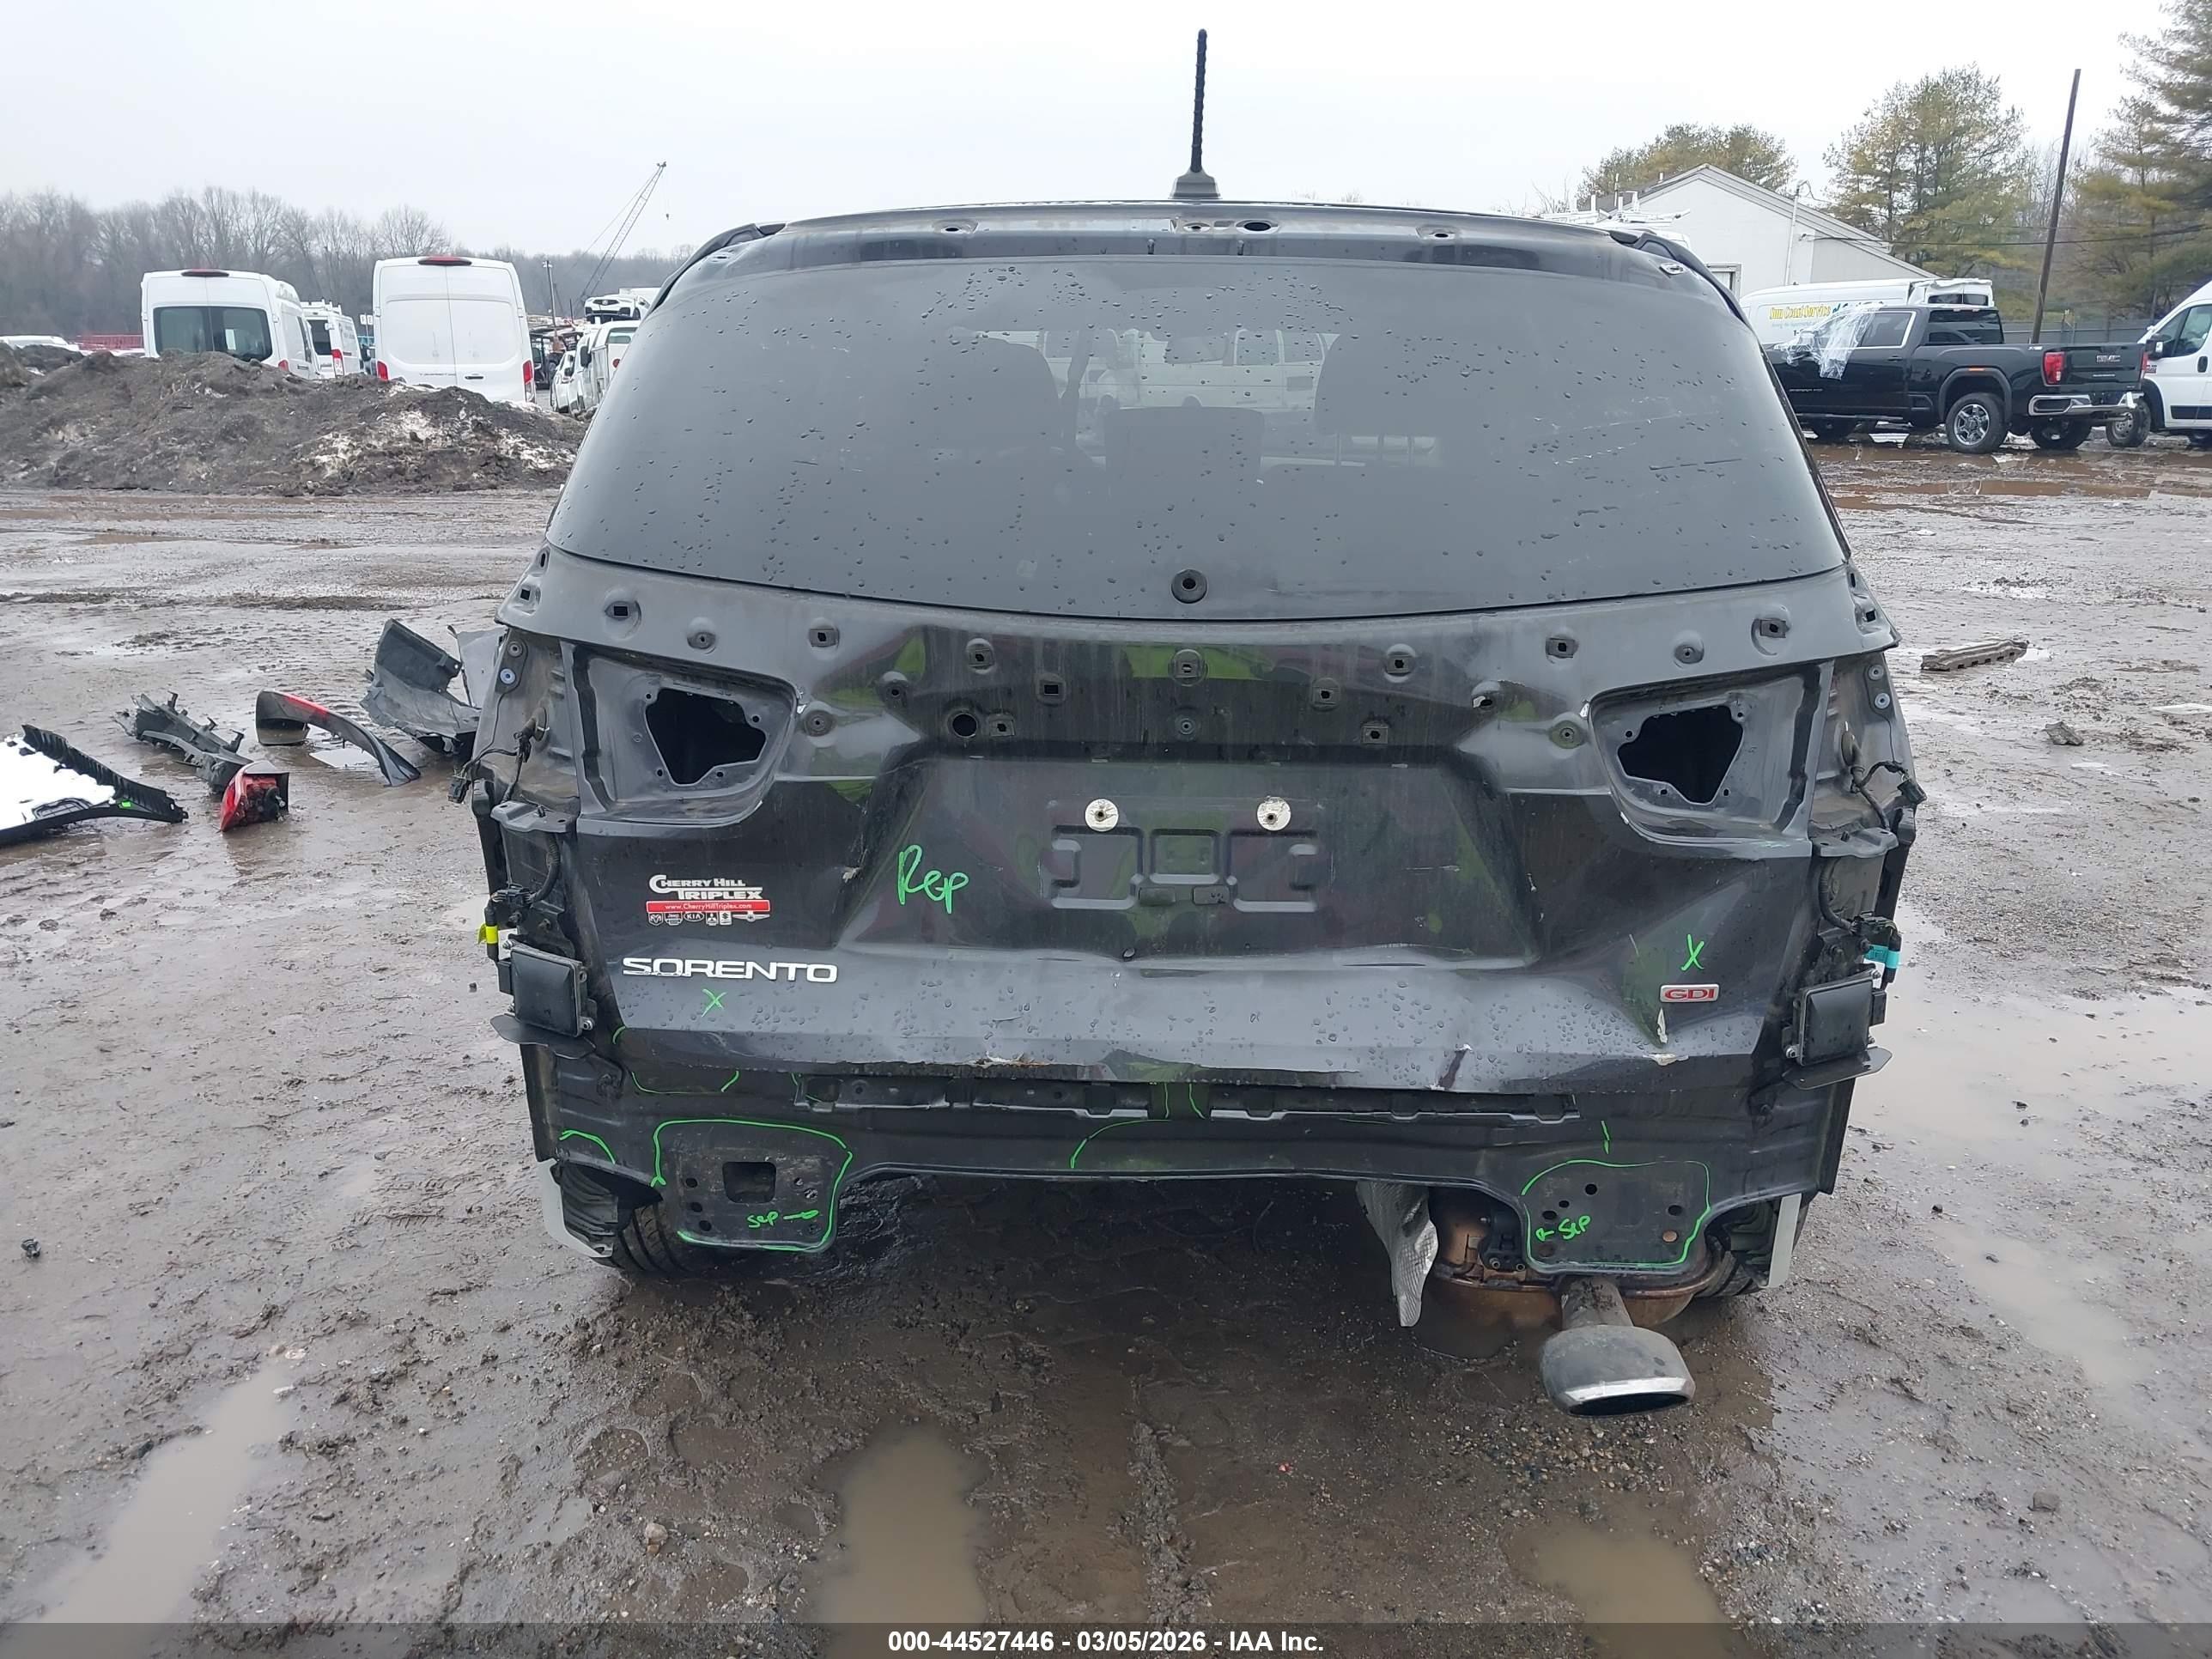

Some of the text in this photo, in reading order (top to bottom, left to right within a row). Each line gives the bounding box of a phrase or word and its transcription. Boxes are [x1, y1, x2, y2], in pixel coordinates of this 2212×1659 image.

[1802, 305, 1831, 318] Service
[665, 902, 752, 911] www.CherryHillTriplex.com
[623, 957, 839, 983] SORENTO
[1664, 988, 1715, 1000] GDI
